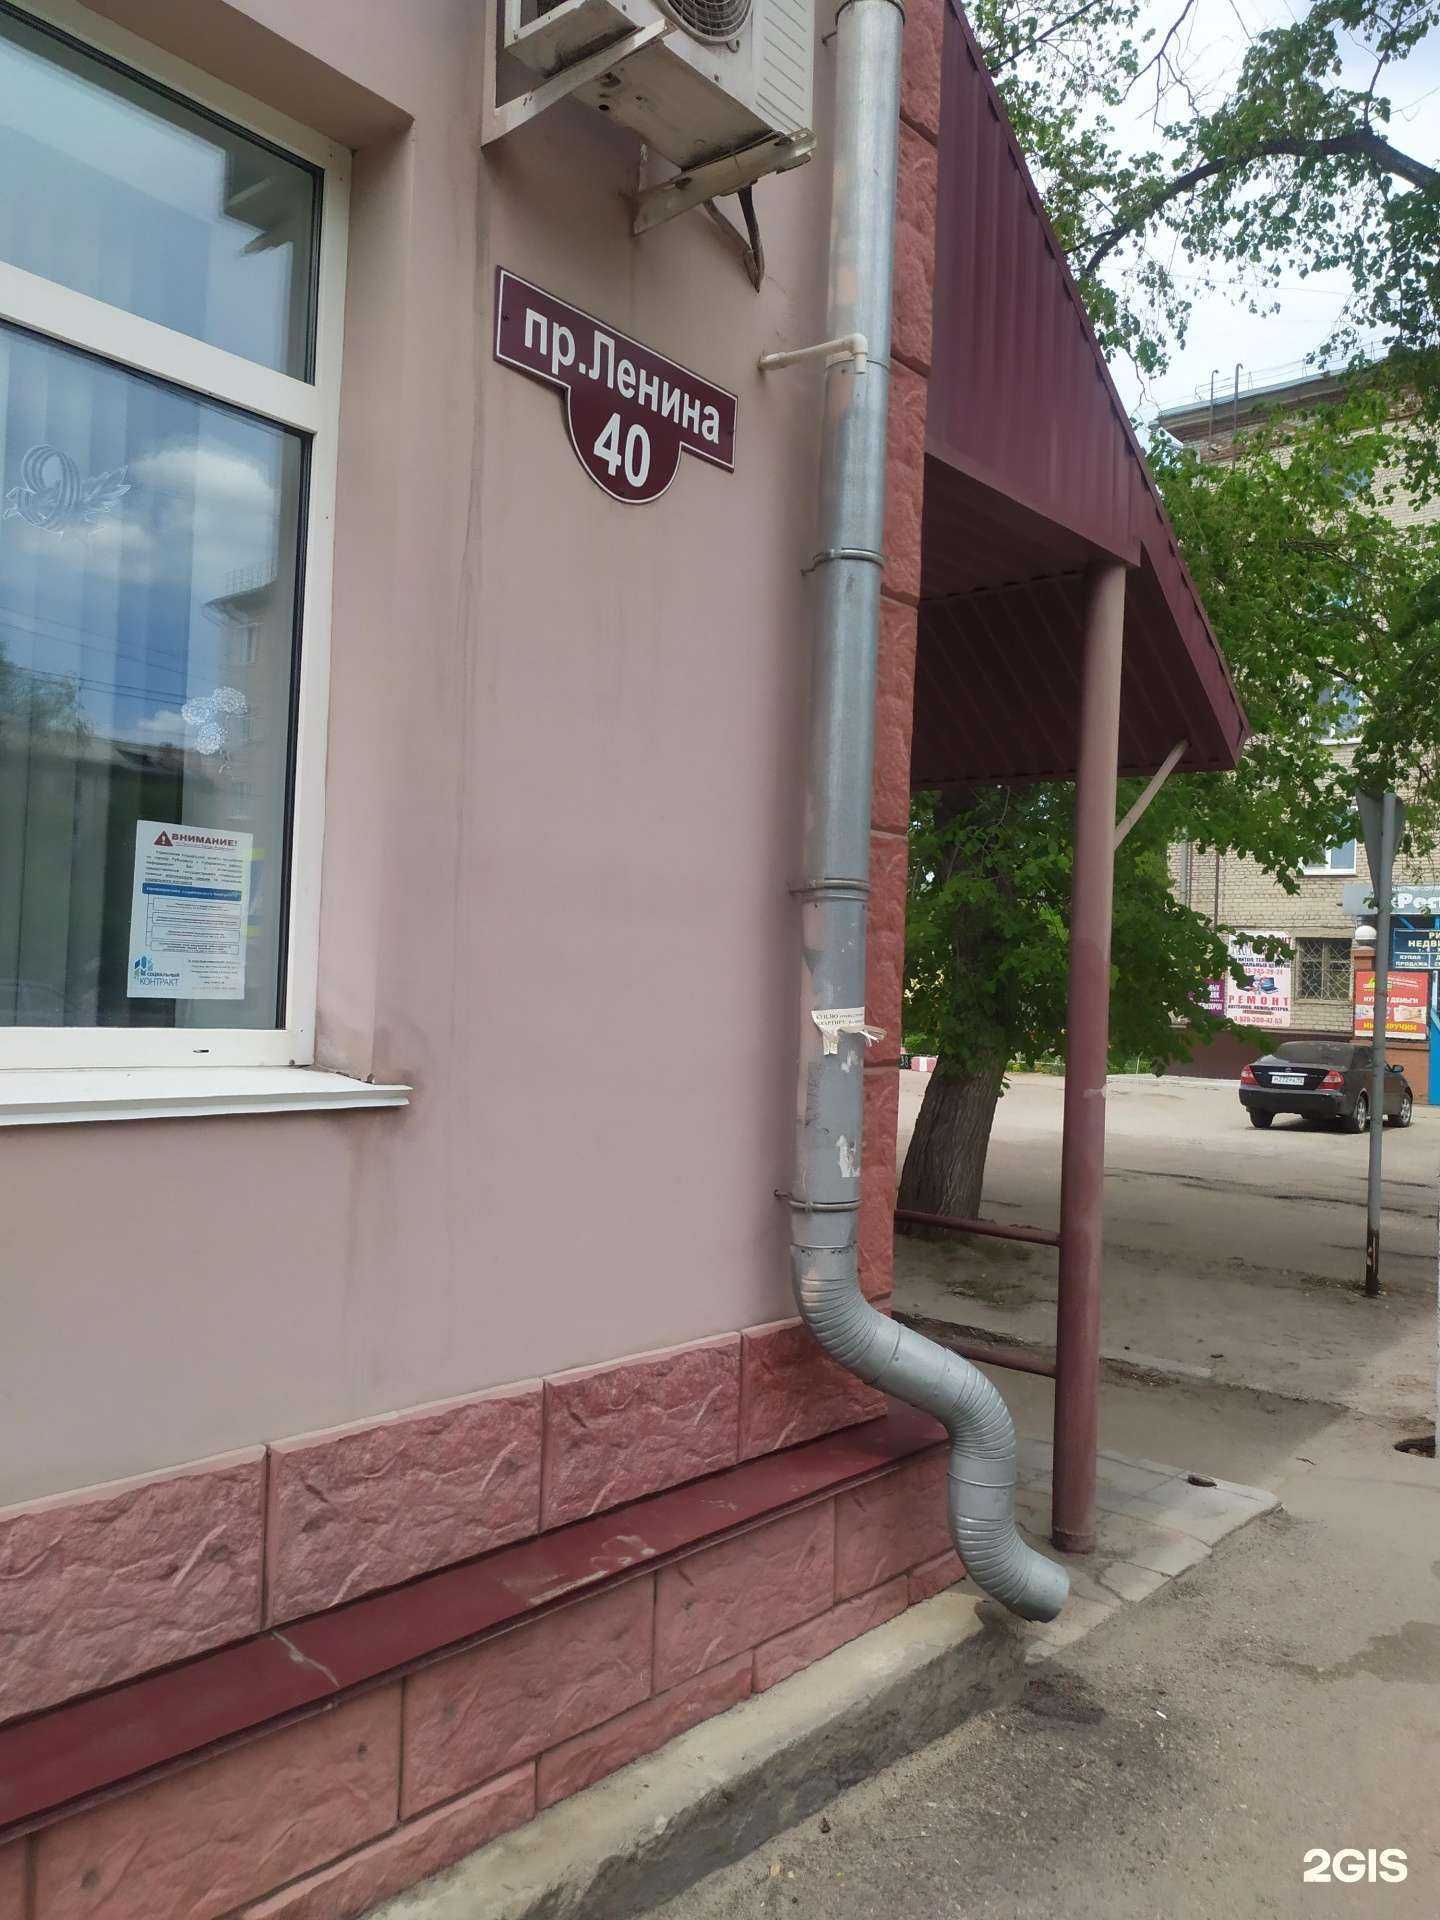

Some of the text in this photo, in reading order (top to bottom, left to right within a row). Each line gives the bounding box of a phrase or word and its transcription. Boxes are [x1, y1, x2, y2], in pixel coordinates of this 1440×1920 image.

[524, 307, 720, 445] пр.Ленина
[593, 412, 651, 488] 40
[171, 832, 238, 847] ВНИМАНИЕ!
[140, 976, 178, 987] КОНТРАКТ
[1228, 995, 1288, 1006] РЕМОНТ
